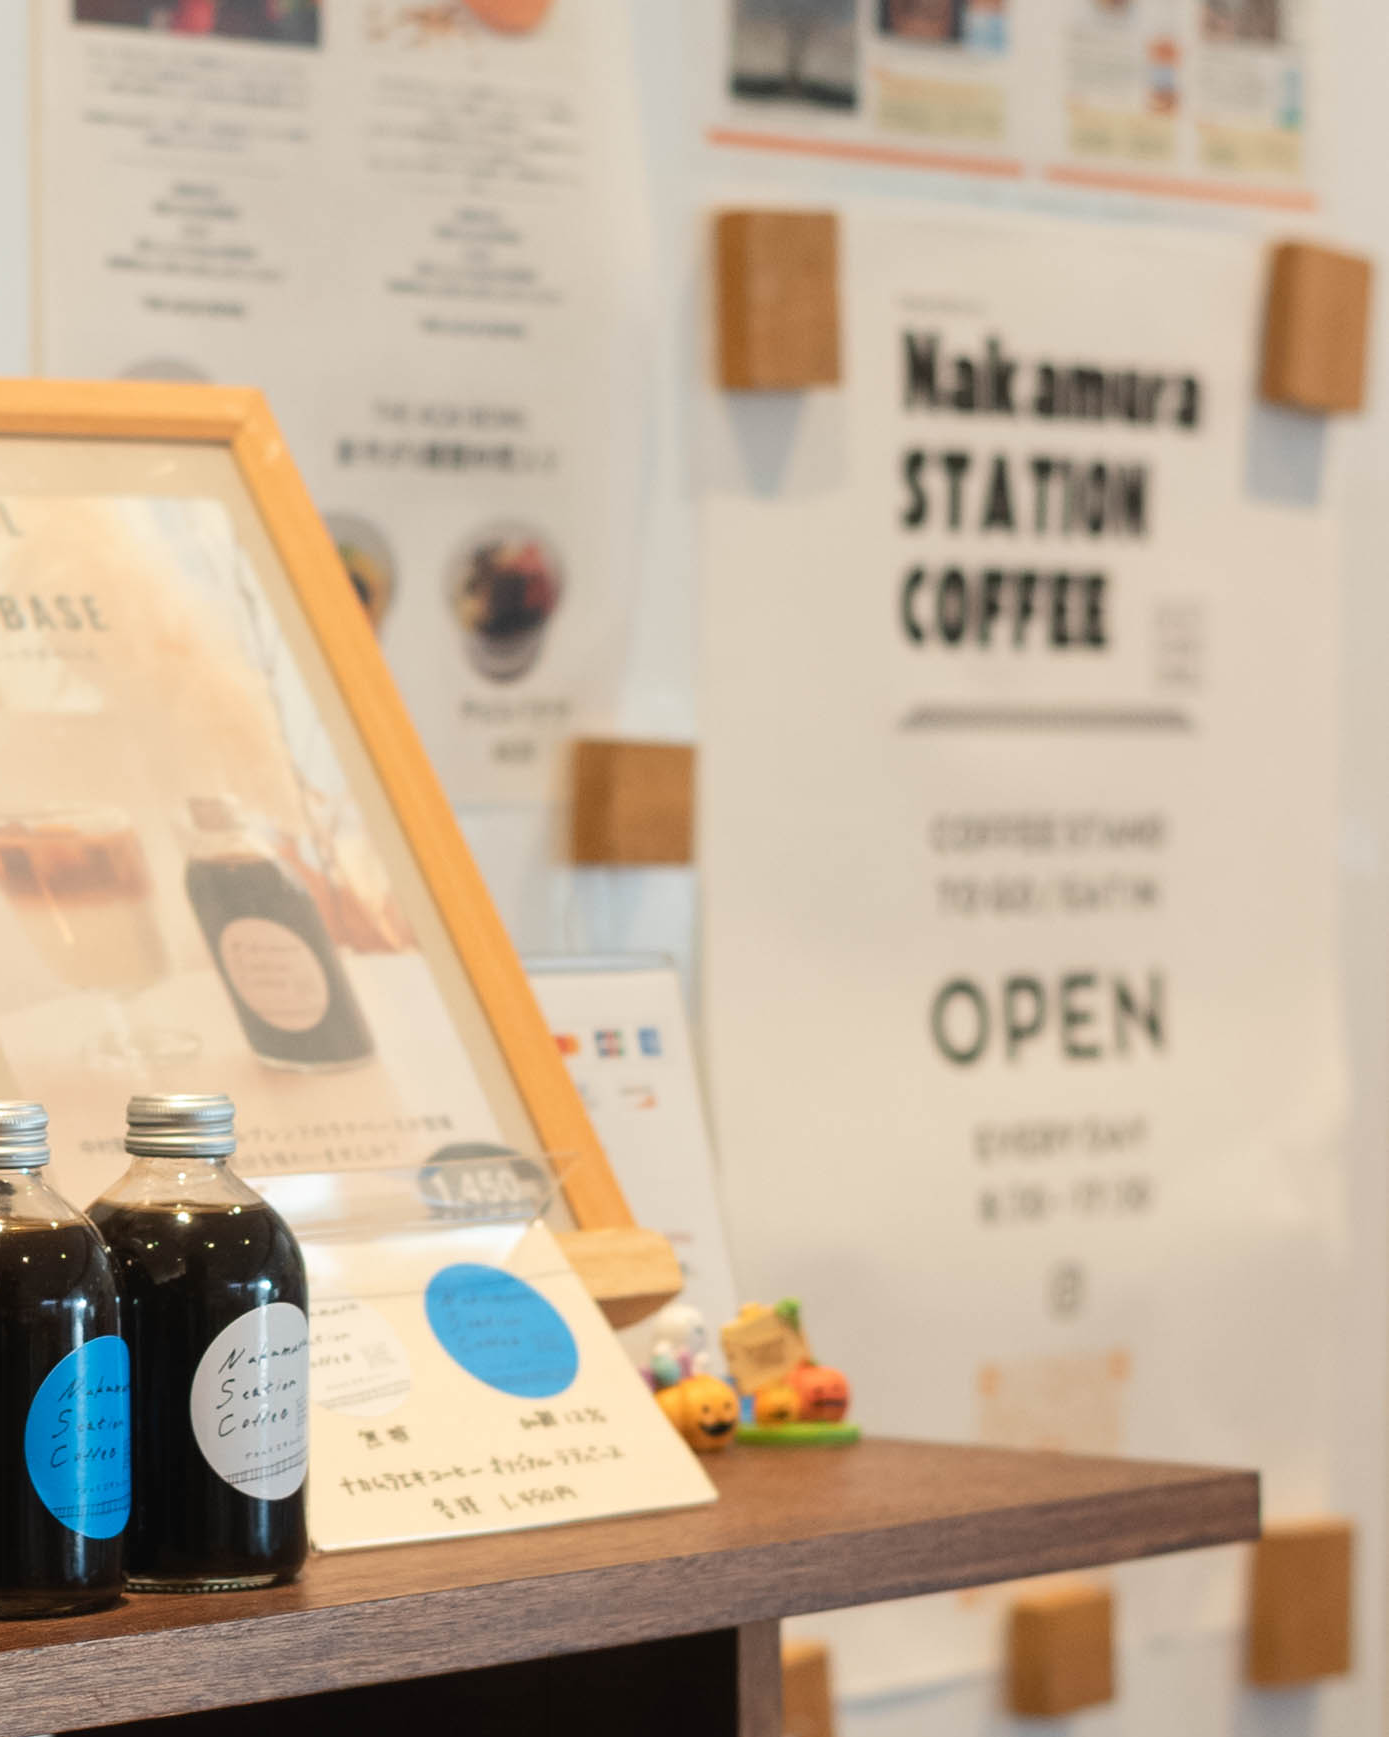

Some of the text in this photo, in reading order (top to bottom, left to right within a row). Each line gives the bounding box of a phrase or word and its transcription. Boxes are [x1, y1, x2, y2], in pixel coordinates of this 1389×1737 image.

[904, 332, 1200, 429] Nakamura
[902, 451, 1148, 536] STATION
[901, 567, 1109, 650] COFFEE
[930, 971, 1166, 1068] OPEN
[50, 1446, 116, 1469] Coffee
[217, 1408, 289, 1437] Coffee
